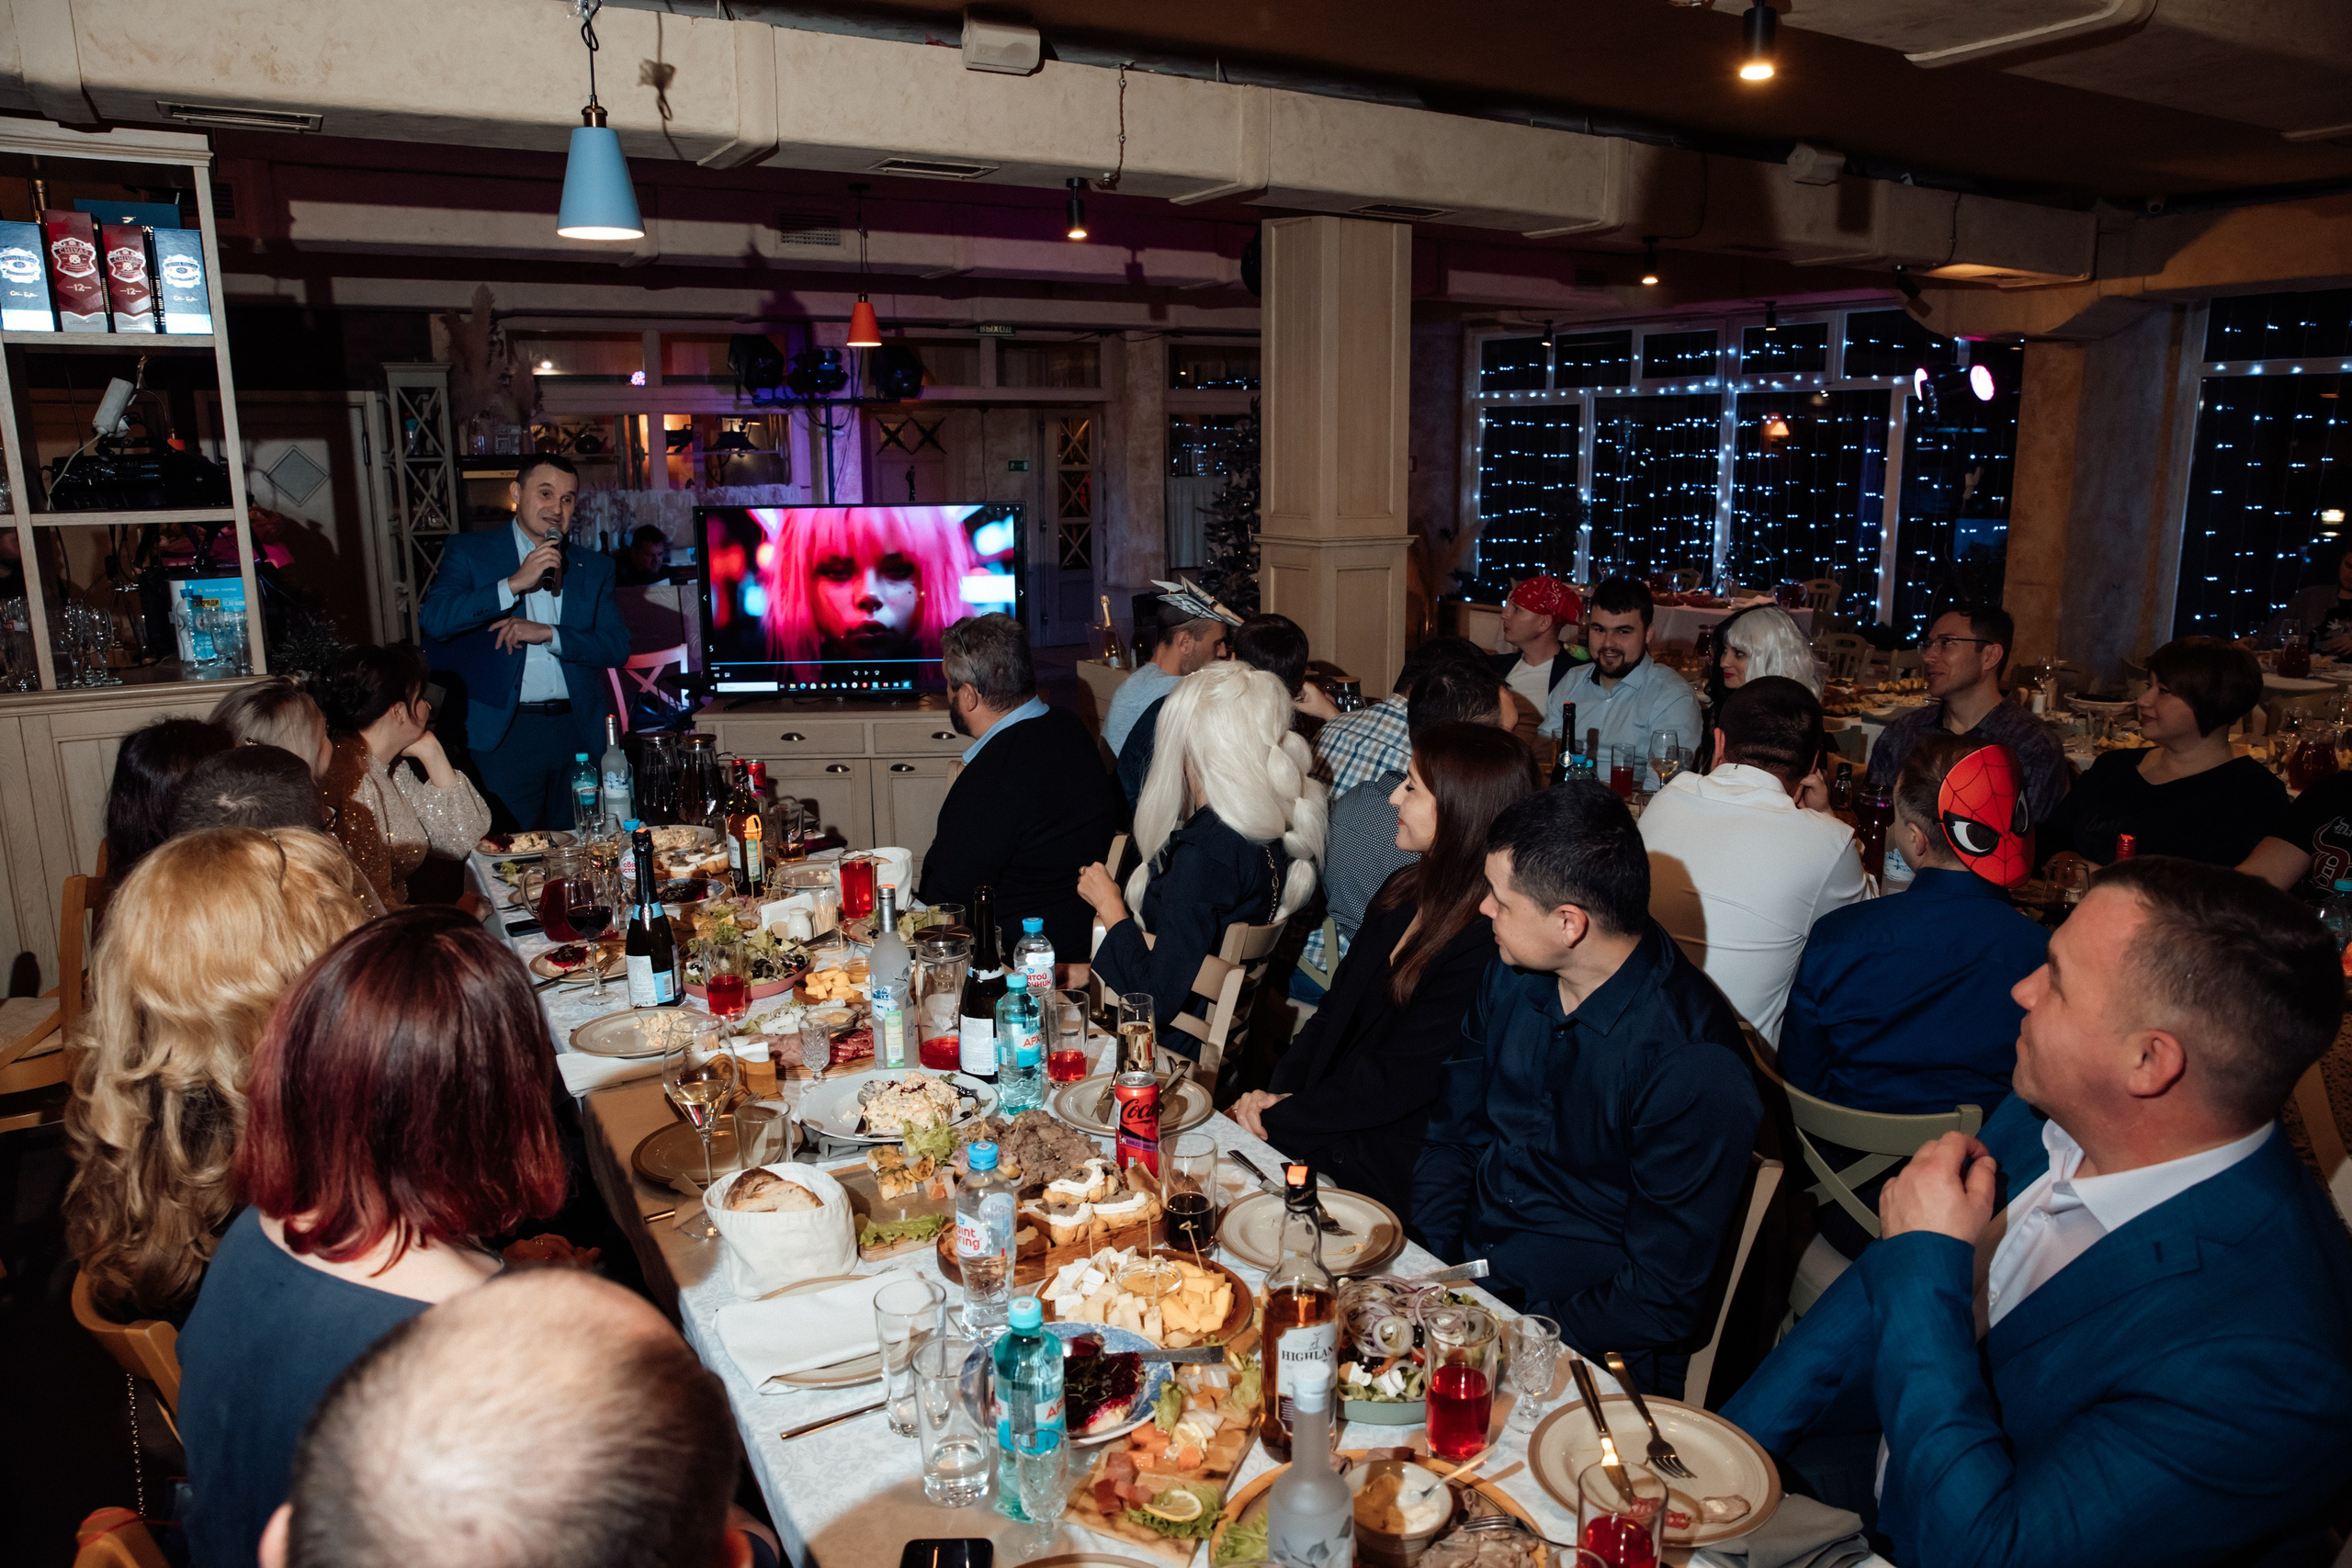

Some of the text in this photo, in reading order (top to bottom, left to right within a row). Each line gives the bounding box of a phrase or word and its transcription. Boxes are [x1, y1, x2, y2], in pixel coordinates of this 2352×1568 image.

[979, 325, 1012, 333] ВЫХОД
[1027, 972, 1047, 981] ЯТОЙ
[1023, 1034, 1041, 1047] АРХ
[956, 1224, 976, 1238] aint
[956, 1235, 980, 1251] ring
[1282, 1346, 1333, 1361] HIGHLAN
